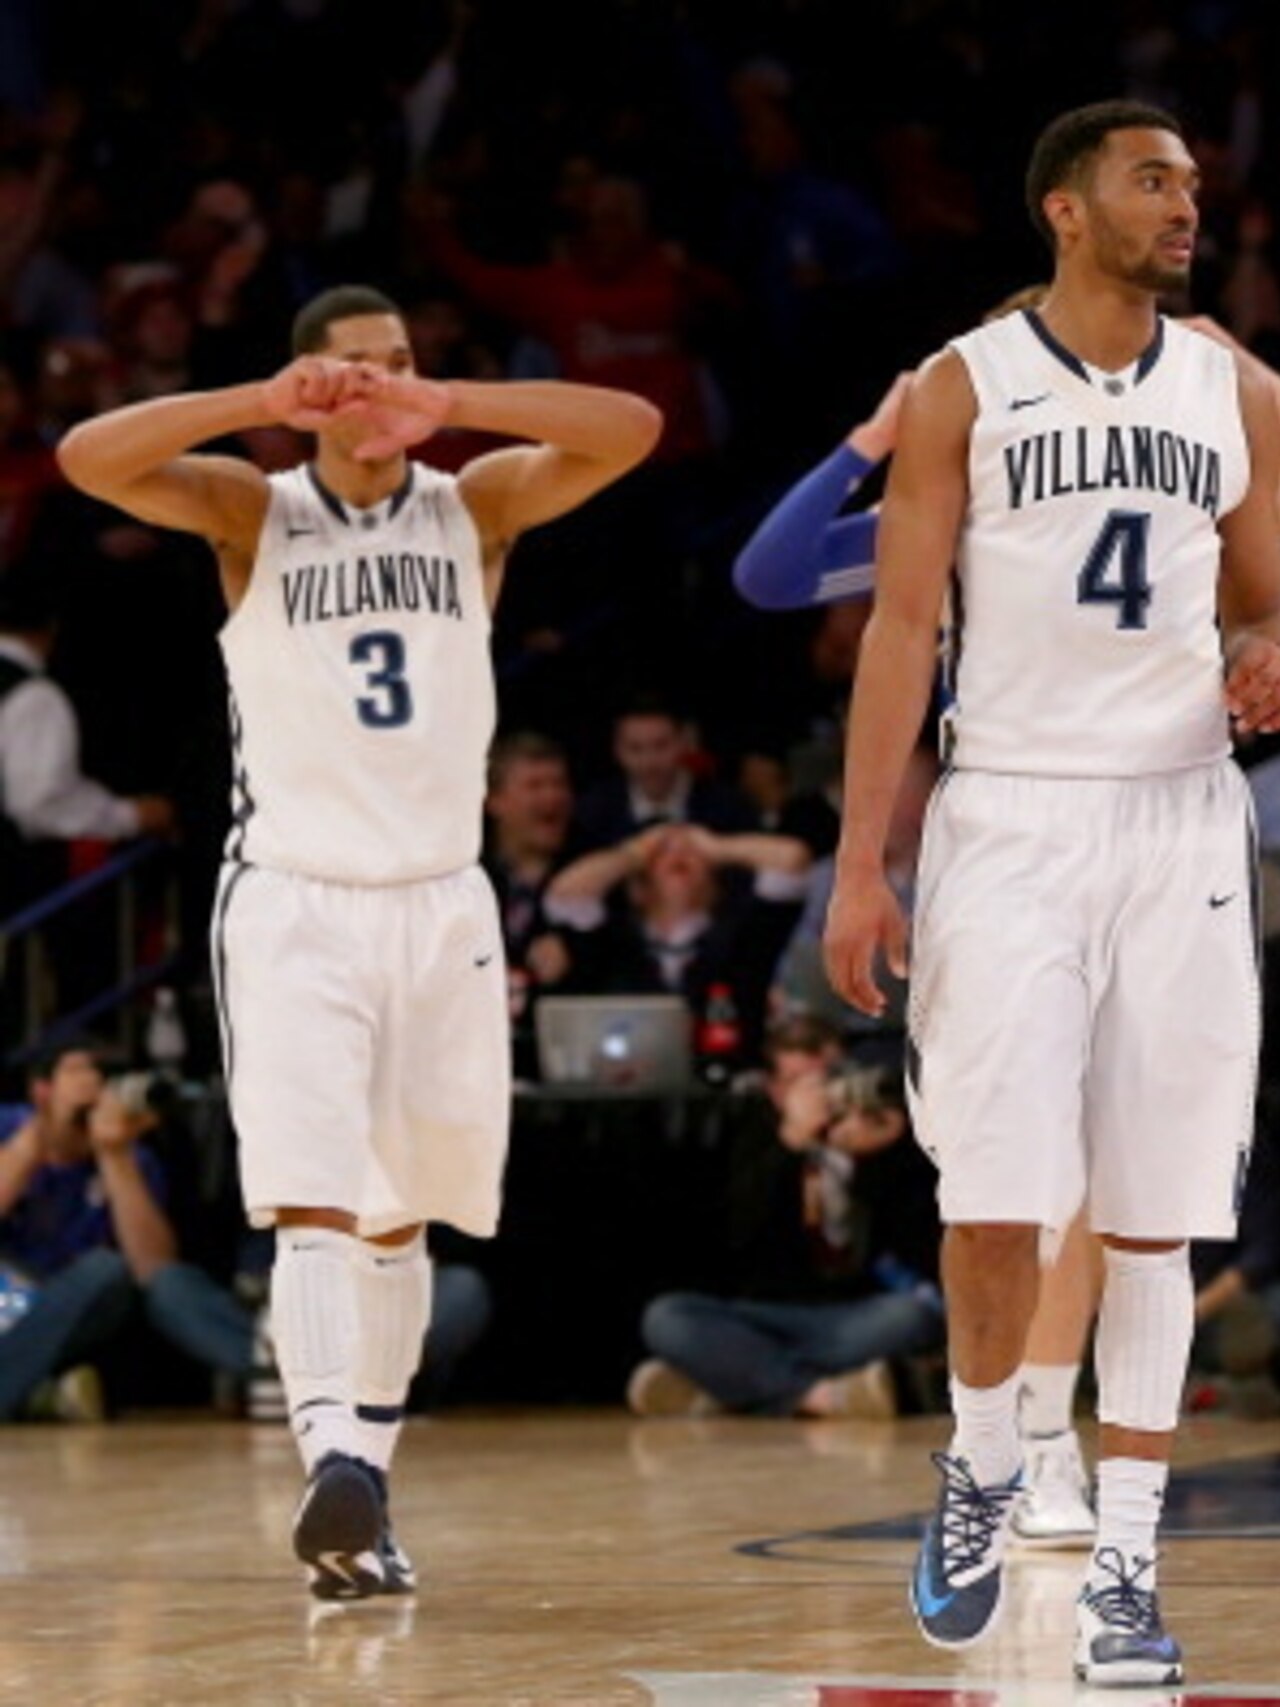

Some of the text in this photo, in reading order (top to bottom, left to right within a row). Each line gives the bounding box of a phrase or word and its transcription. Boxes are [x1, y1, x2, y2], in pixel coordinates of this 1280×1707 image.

[1004, 424, 1221, 520] VILLANOVA
[281, 552, 463, 627] VILLANOVA
[1077, 508, 1154, 630] 4
[349, 630, 414, 729] 3
